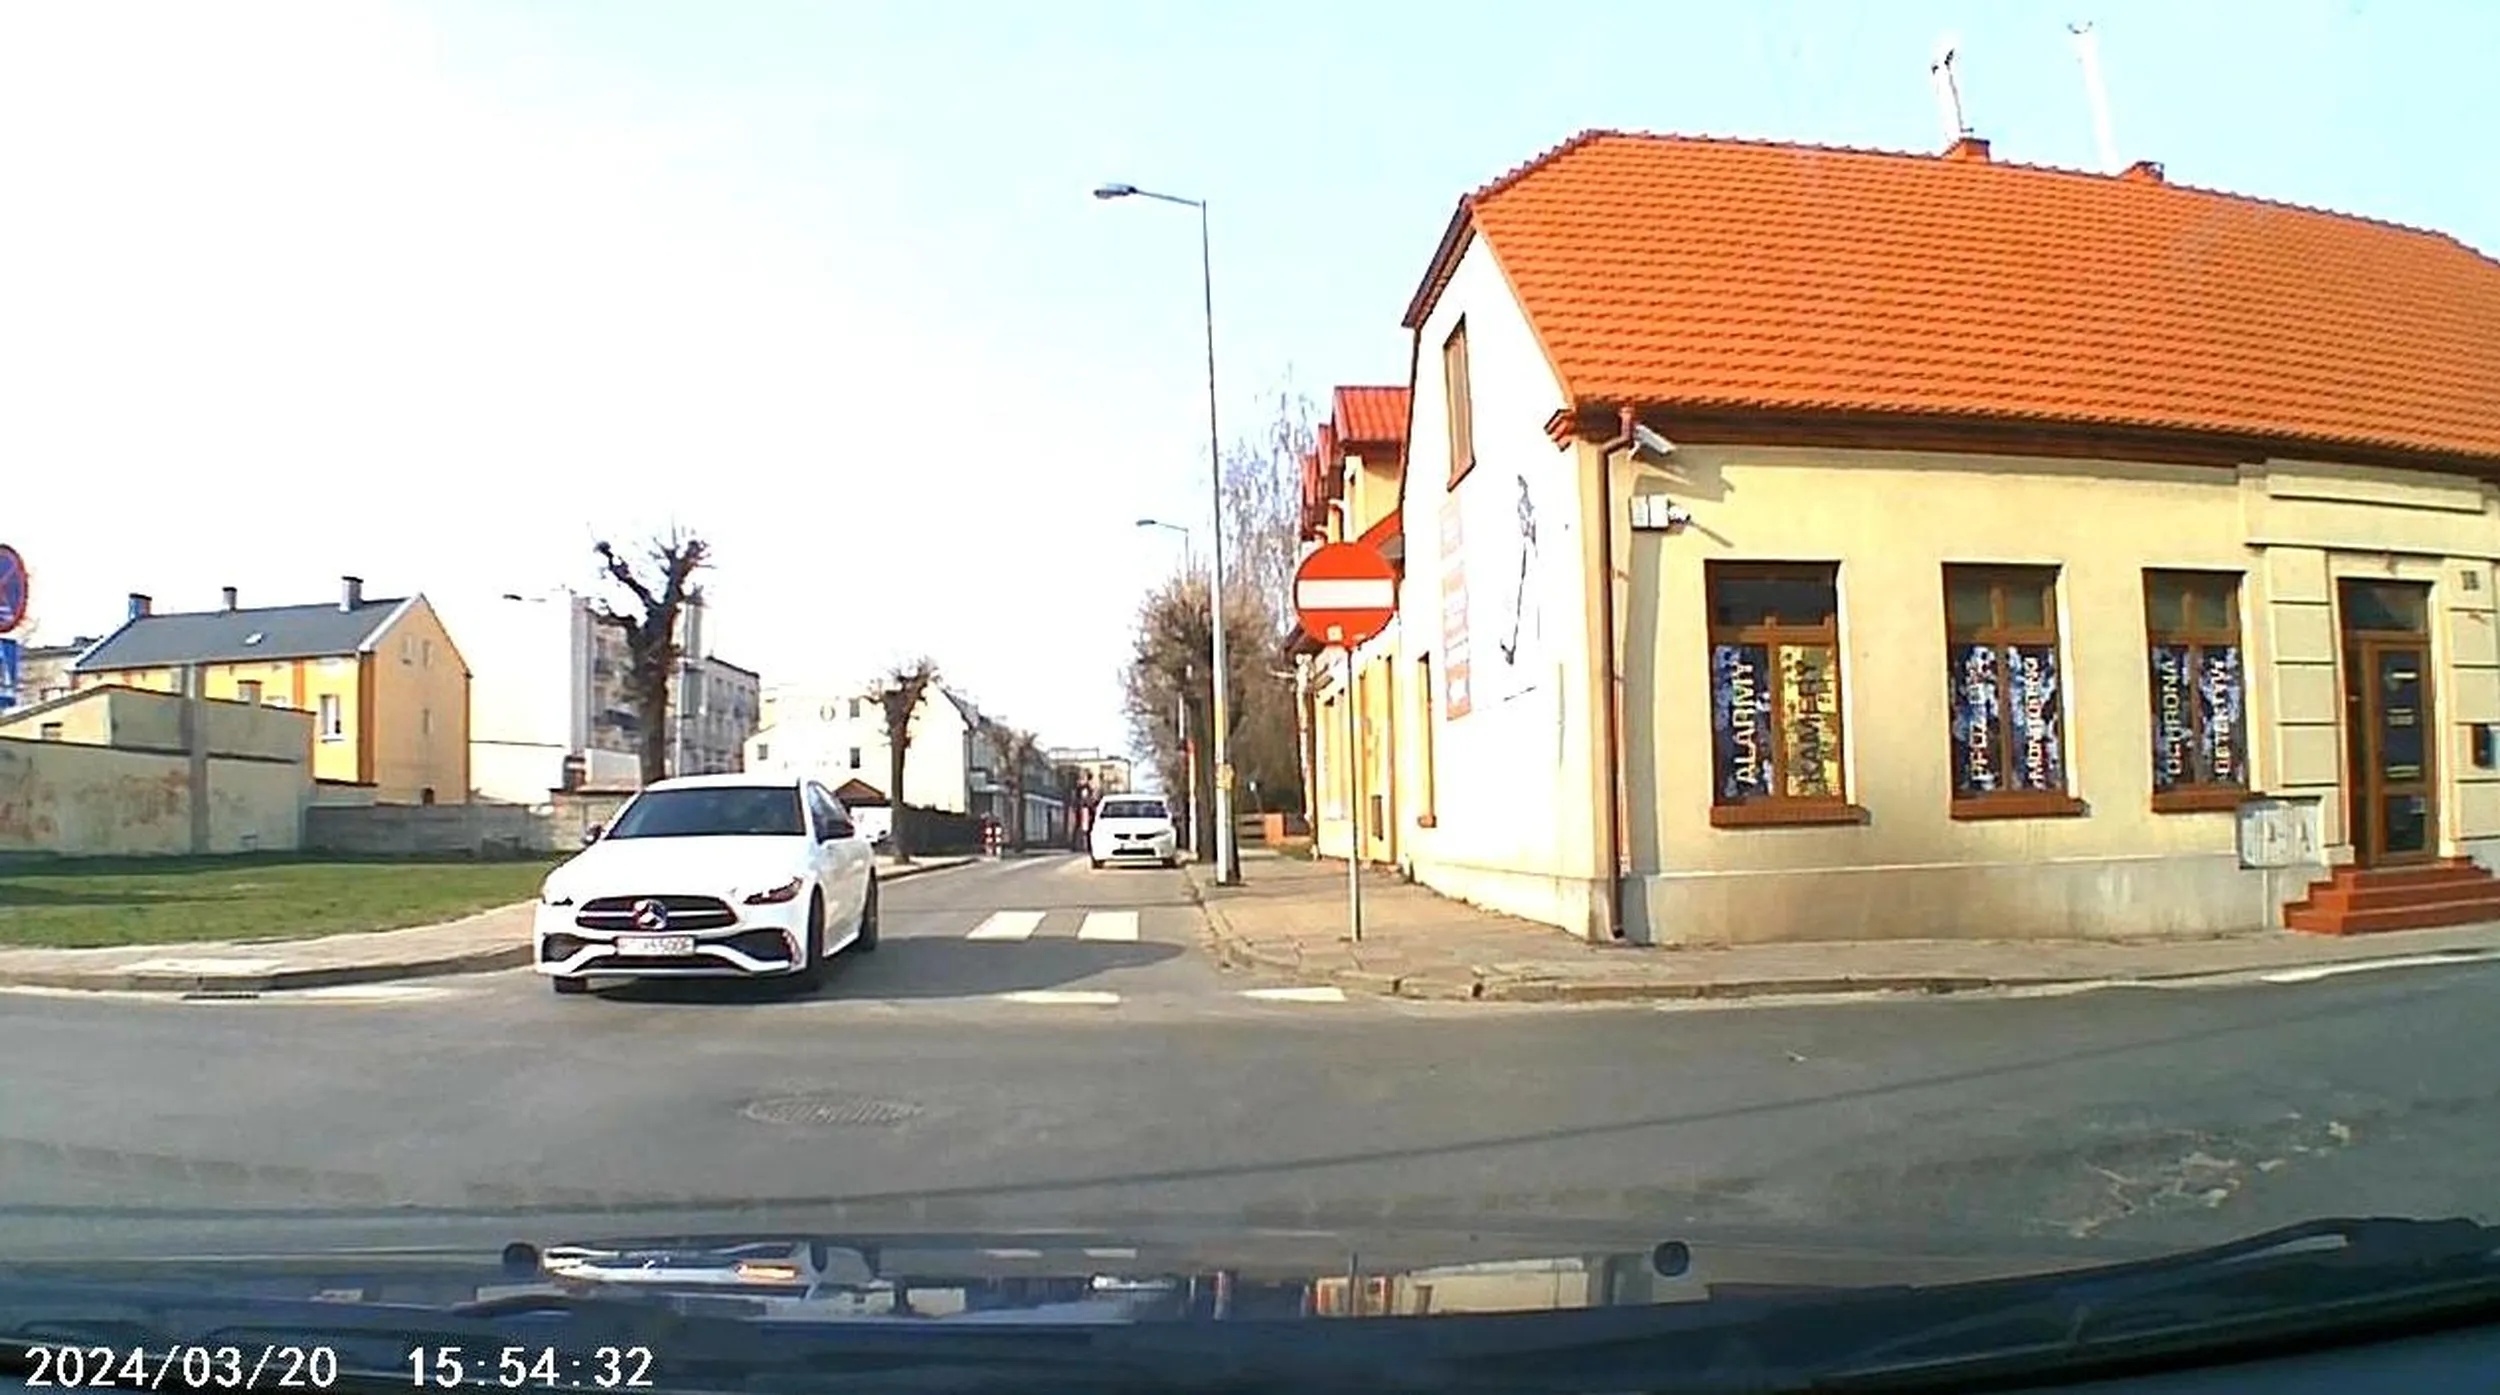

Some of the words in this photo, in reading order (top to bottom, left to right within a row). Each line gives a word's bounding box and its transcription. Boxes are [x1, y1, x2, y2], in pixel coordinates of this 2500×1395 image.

[1730, 660, 1758, 784] ALARMY
[1795, 659, 1823, 783] KAMERY
[2160, 658, 2182, 775] OCHRONA
